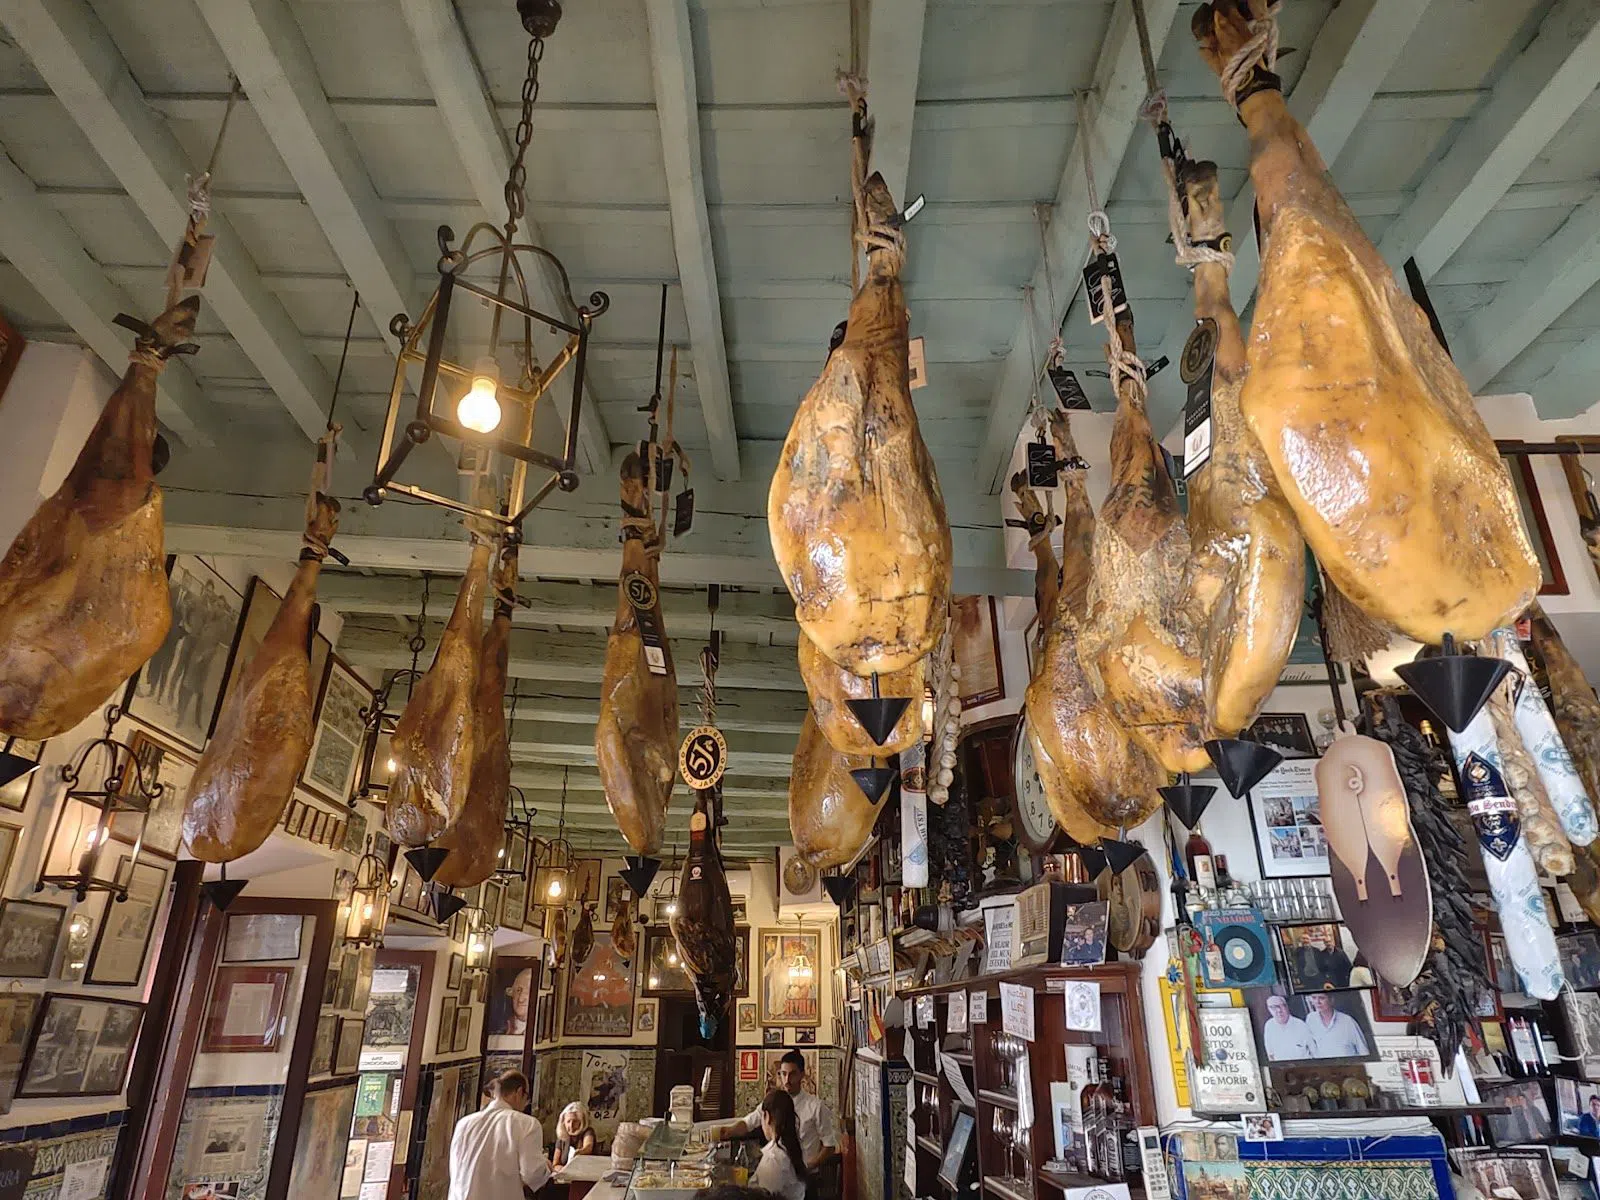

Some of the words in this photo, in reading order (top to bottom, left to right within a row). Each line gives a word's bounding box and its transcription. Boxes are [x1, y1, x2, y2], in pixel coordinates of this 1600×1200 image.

[1204, 1025, 1232, 1037] 1.000
[1226, 1052, 1247, 1061] VER
[1394, 1049, 1436, 1059] TERESAS
[1208, 1064, 1240, 1073] ANTES
[1202, 1076, 1216, 1085] DE
[1217, 1076, 1249, 1085] MORIR
